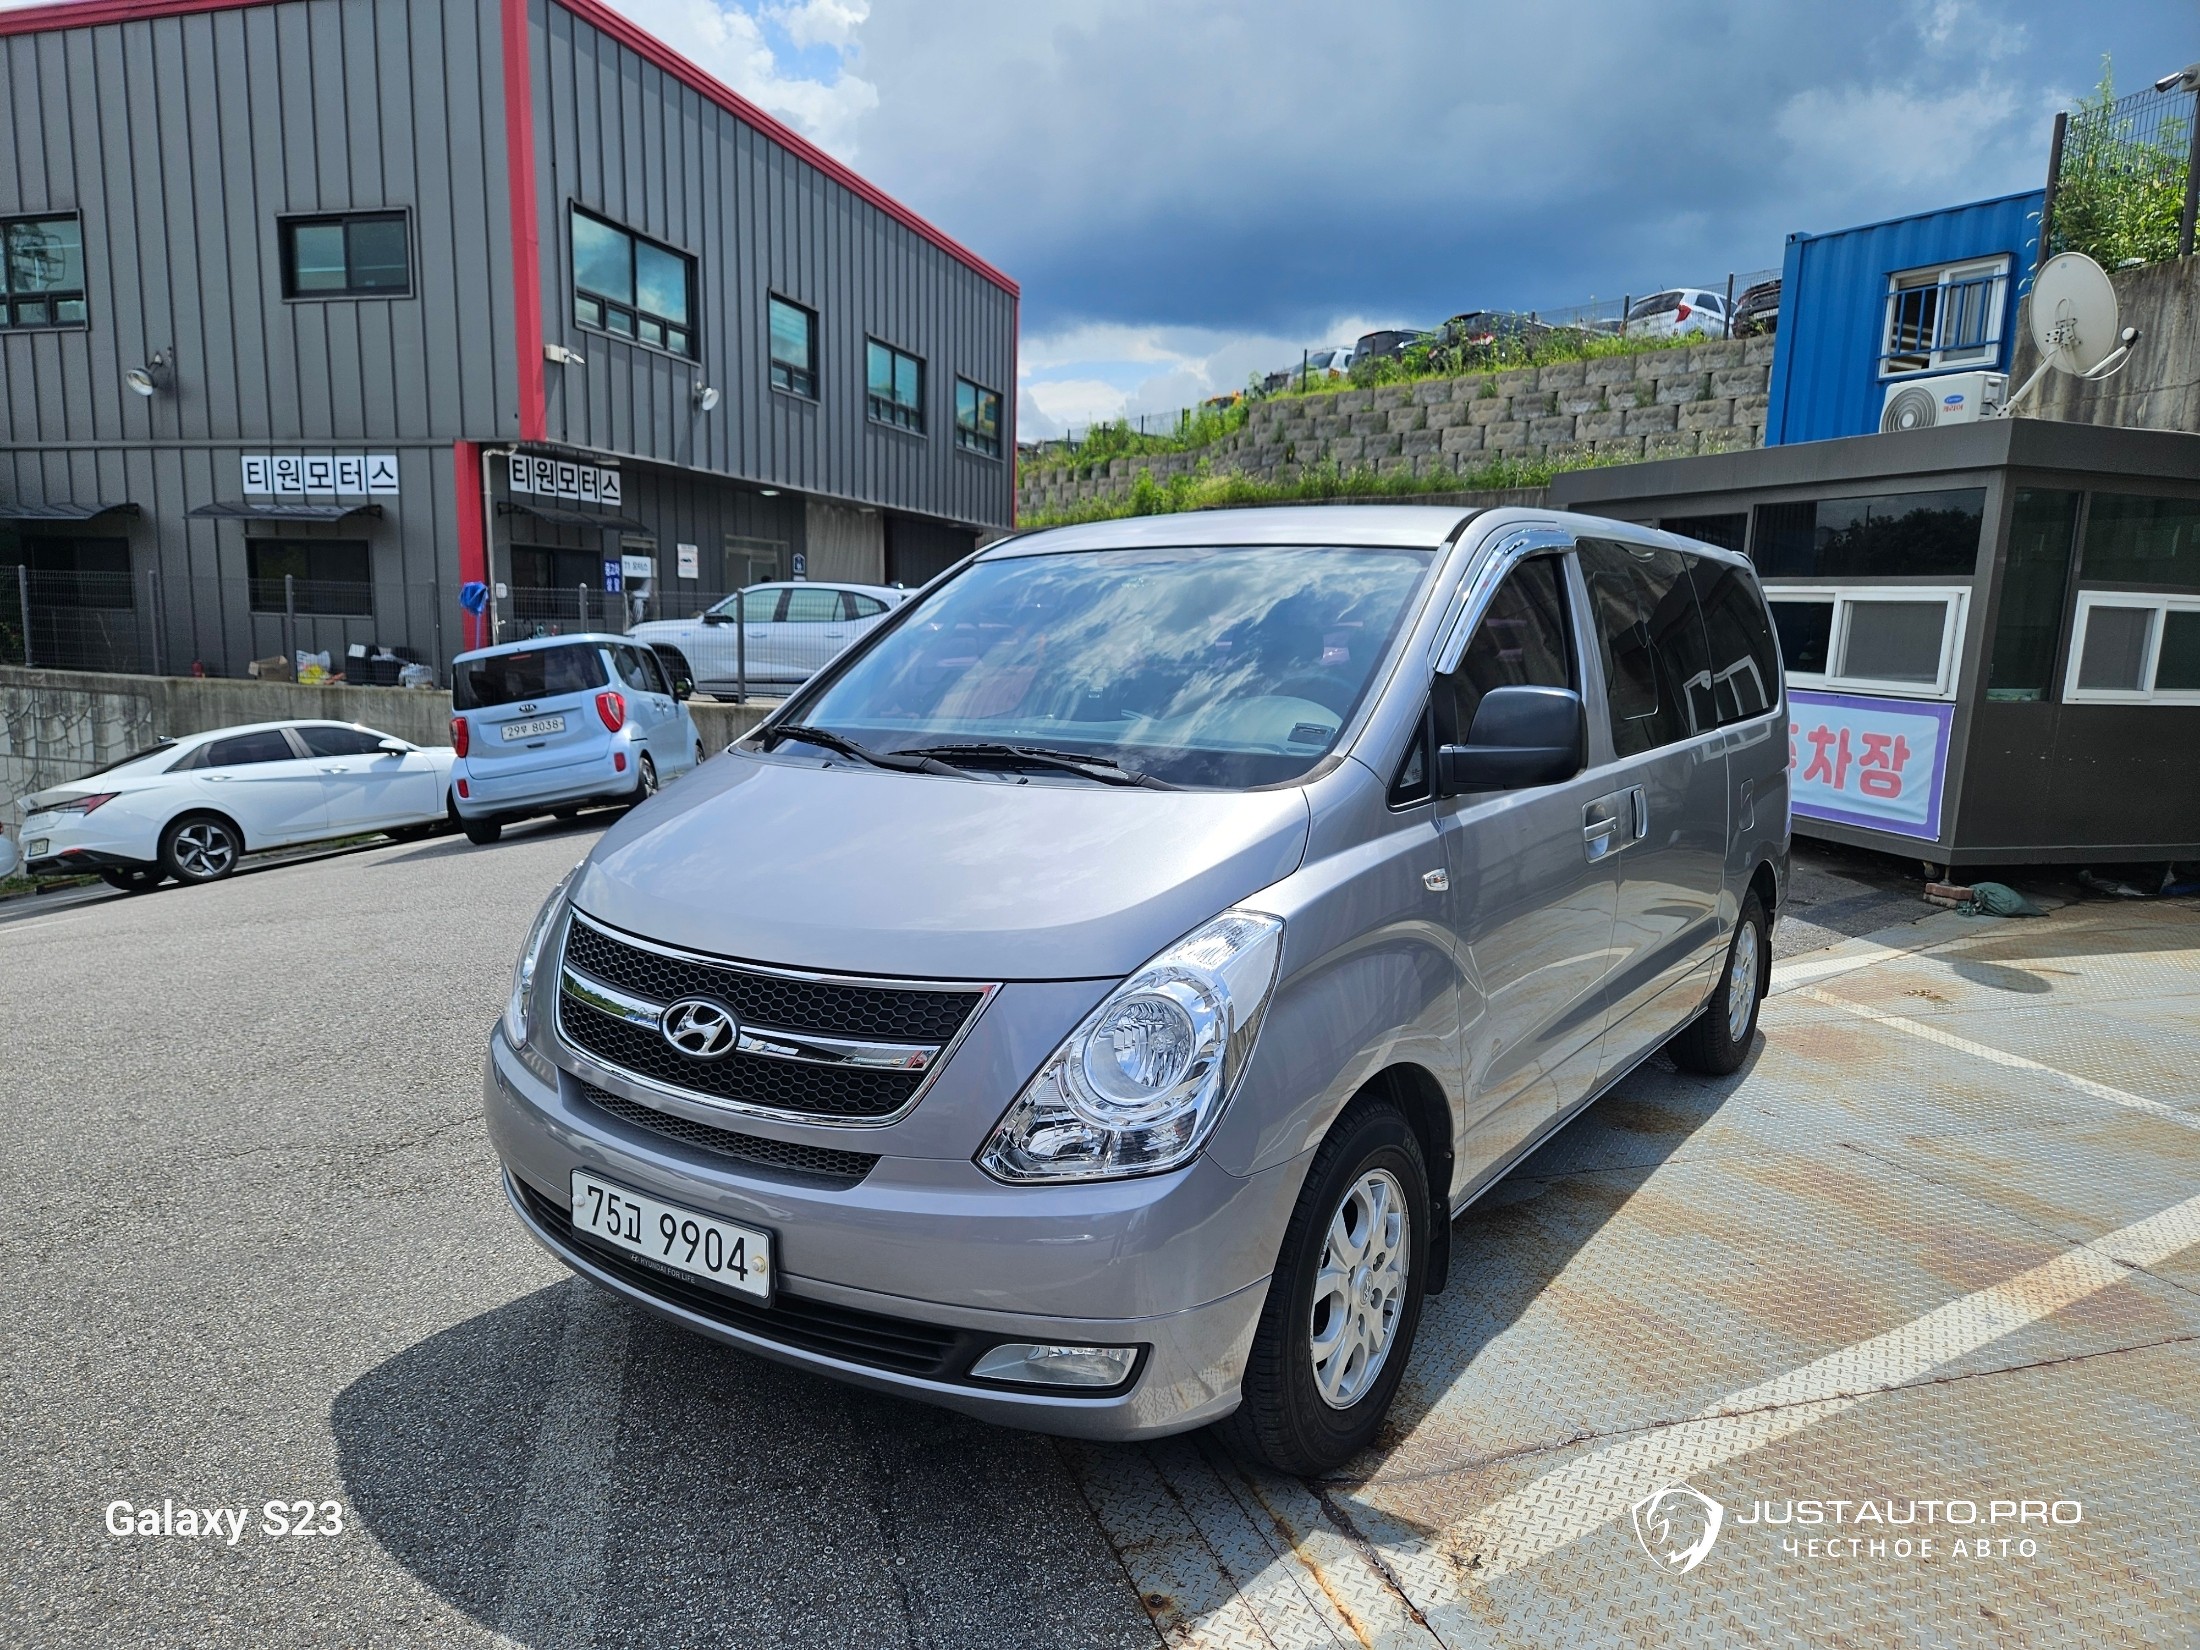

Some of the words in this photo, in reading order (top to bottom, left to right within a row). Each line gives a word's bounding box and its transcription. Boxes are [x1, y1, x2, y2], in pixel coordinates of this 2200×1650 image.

[246, 459, 397, 491] 티원모터스
[511, 458, 620, 500] 티원모터스
[532, 720, 559, 732] 8038
[1790, 723, 1911, 799] 차장
[587, 1184, 642, 1245] 75고
[659, 1212, 749, 1282] 9904
[640, 1257, 667, 1274] HYUNDAI
[667, 1268, 680, 1279] FOR
[681, 1273, 696, 1284] LIFE
